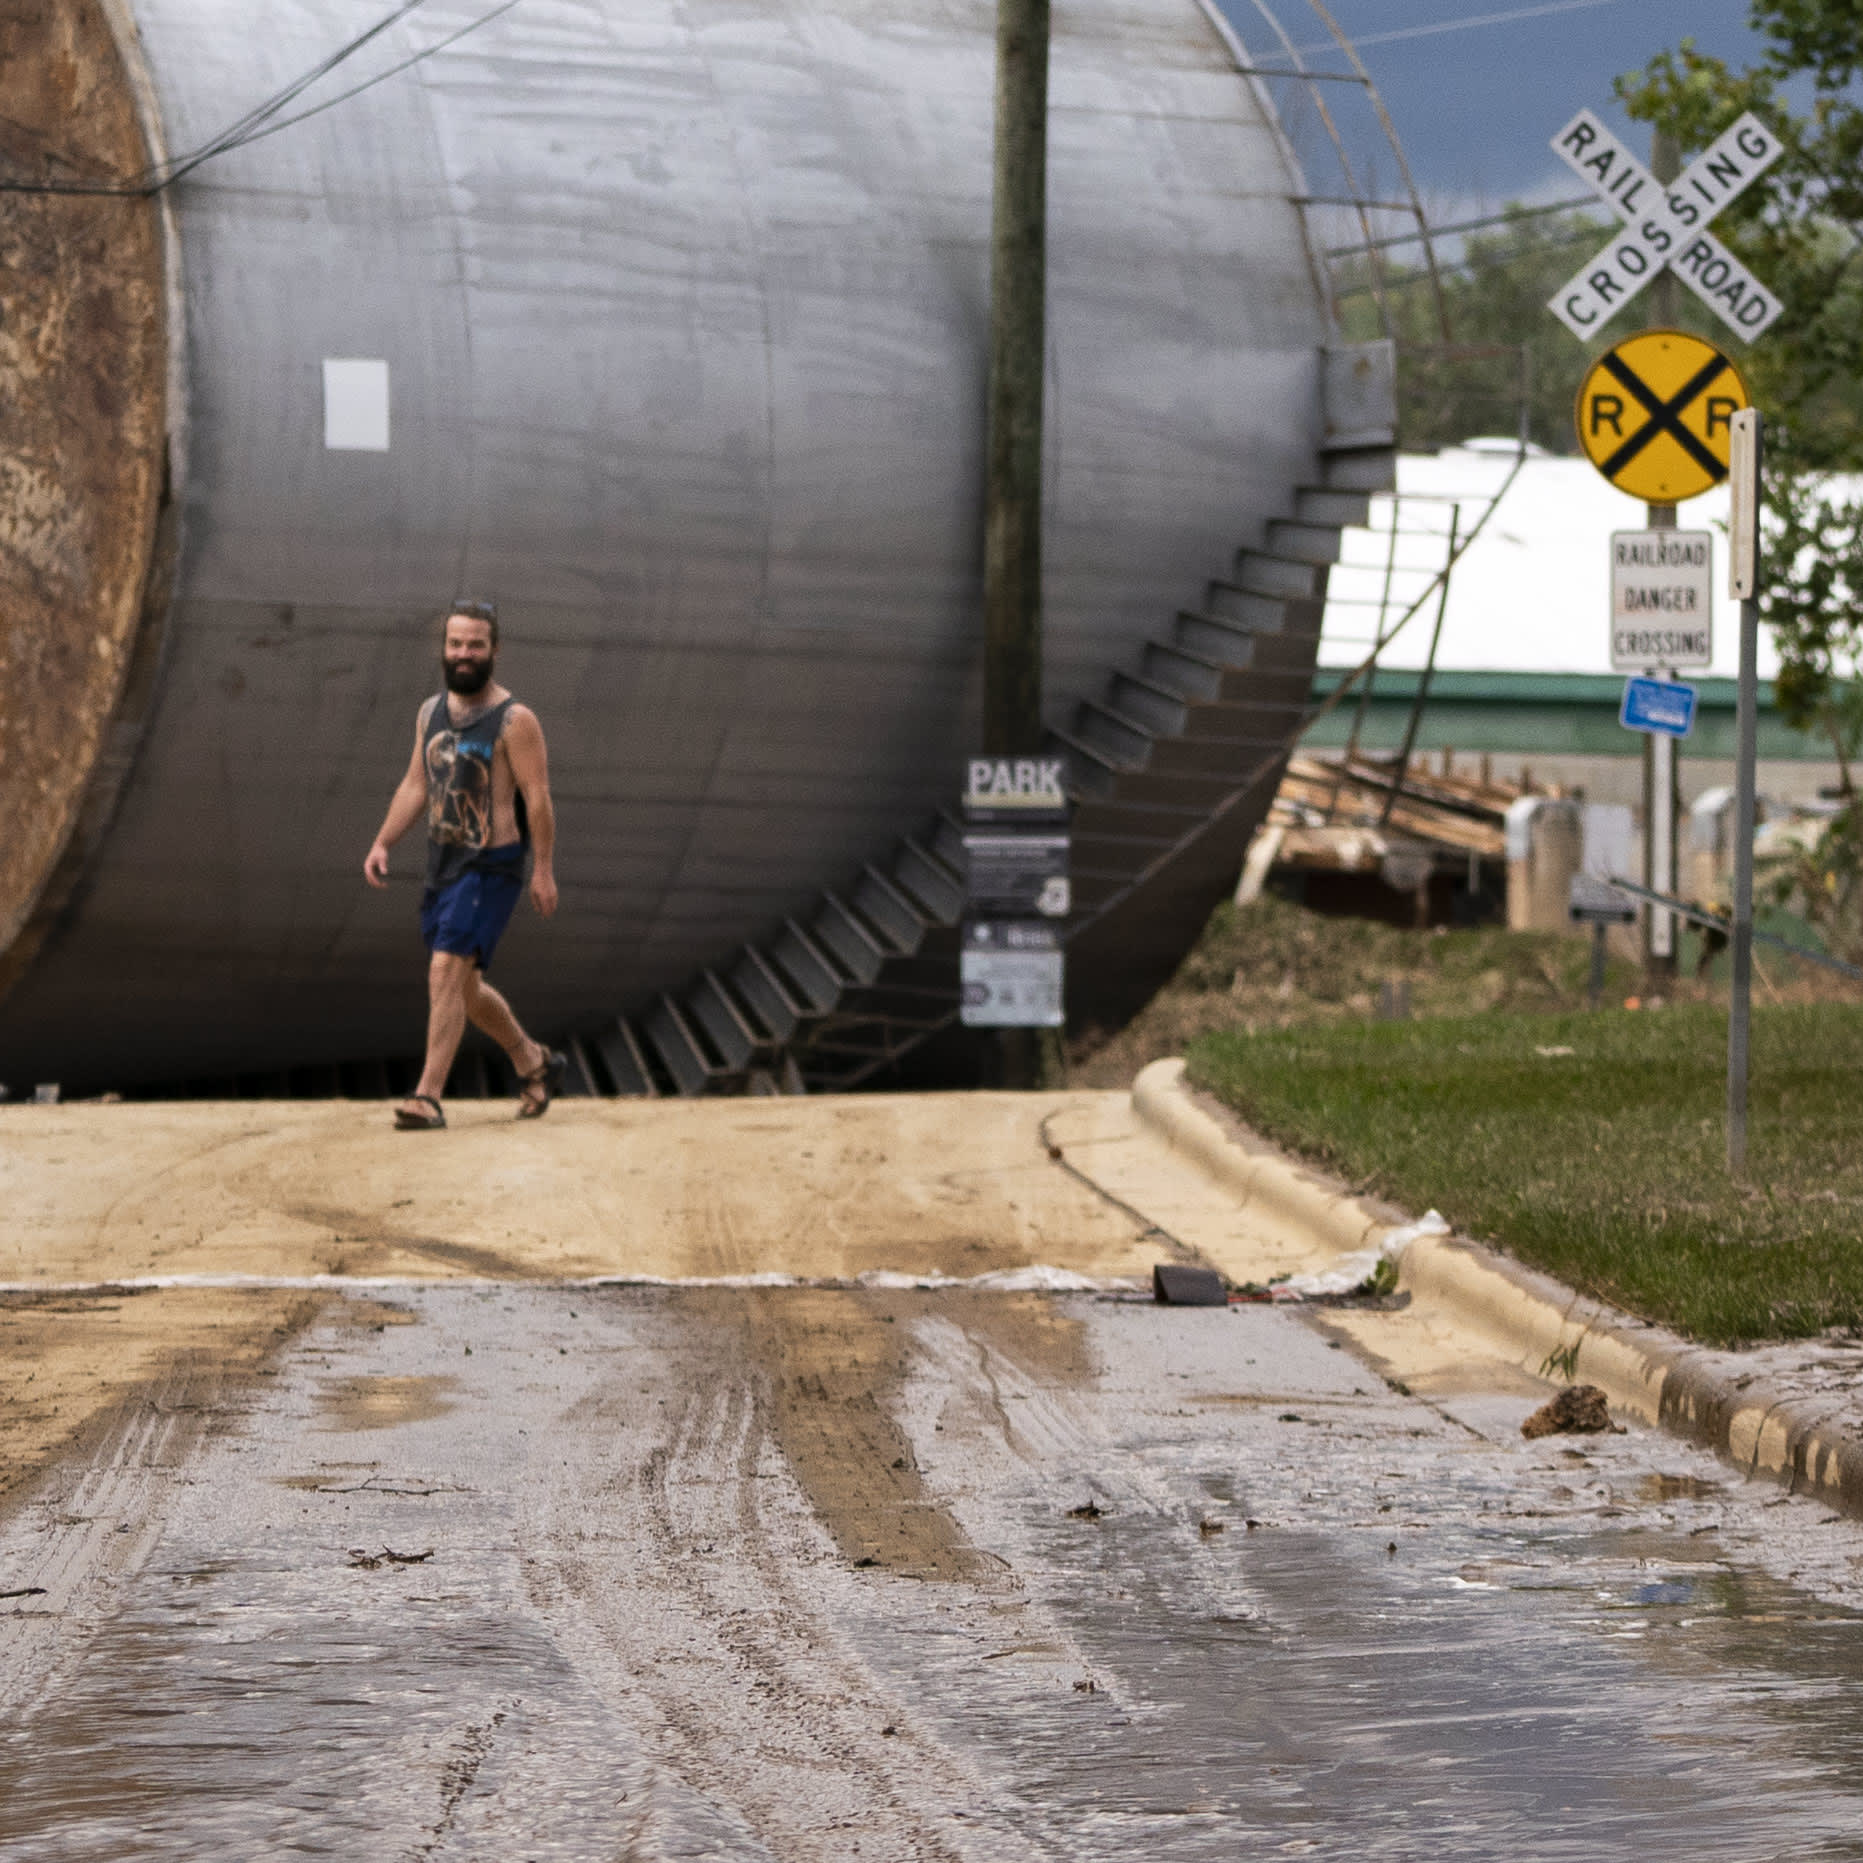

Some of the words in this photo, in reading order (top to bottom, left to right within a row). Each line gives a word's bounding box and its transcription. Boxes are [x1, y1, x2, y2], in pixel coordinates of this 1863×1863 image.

[1561, 121, 1645, 215] RAIL
[1679, 239, 1768, 328] ROAD
[1565, 127, 1769, 327] CROSSING
[1590, 394, 1625, 437] R
[1705, 396, 1733, 439] R
[1615, 542, 1707, 569] RAILROAD
[1624, 587, 1698, 613] DANGER
[1613, 631, 1707, 657] CROSSING
[968, 758, 1062, 797] PARK
